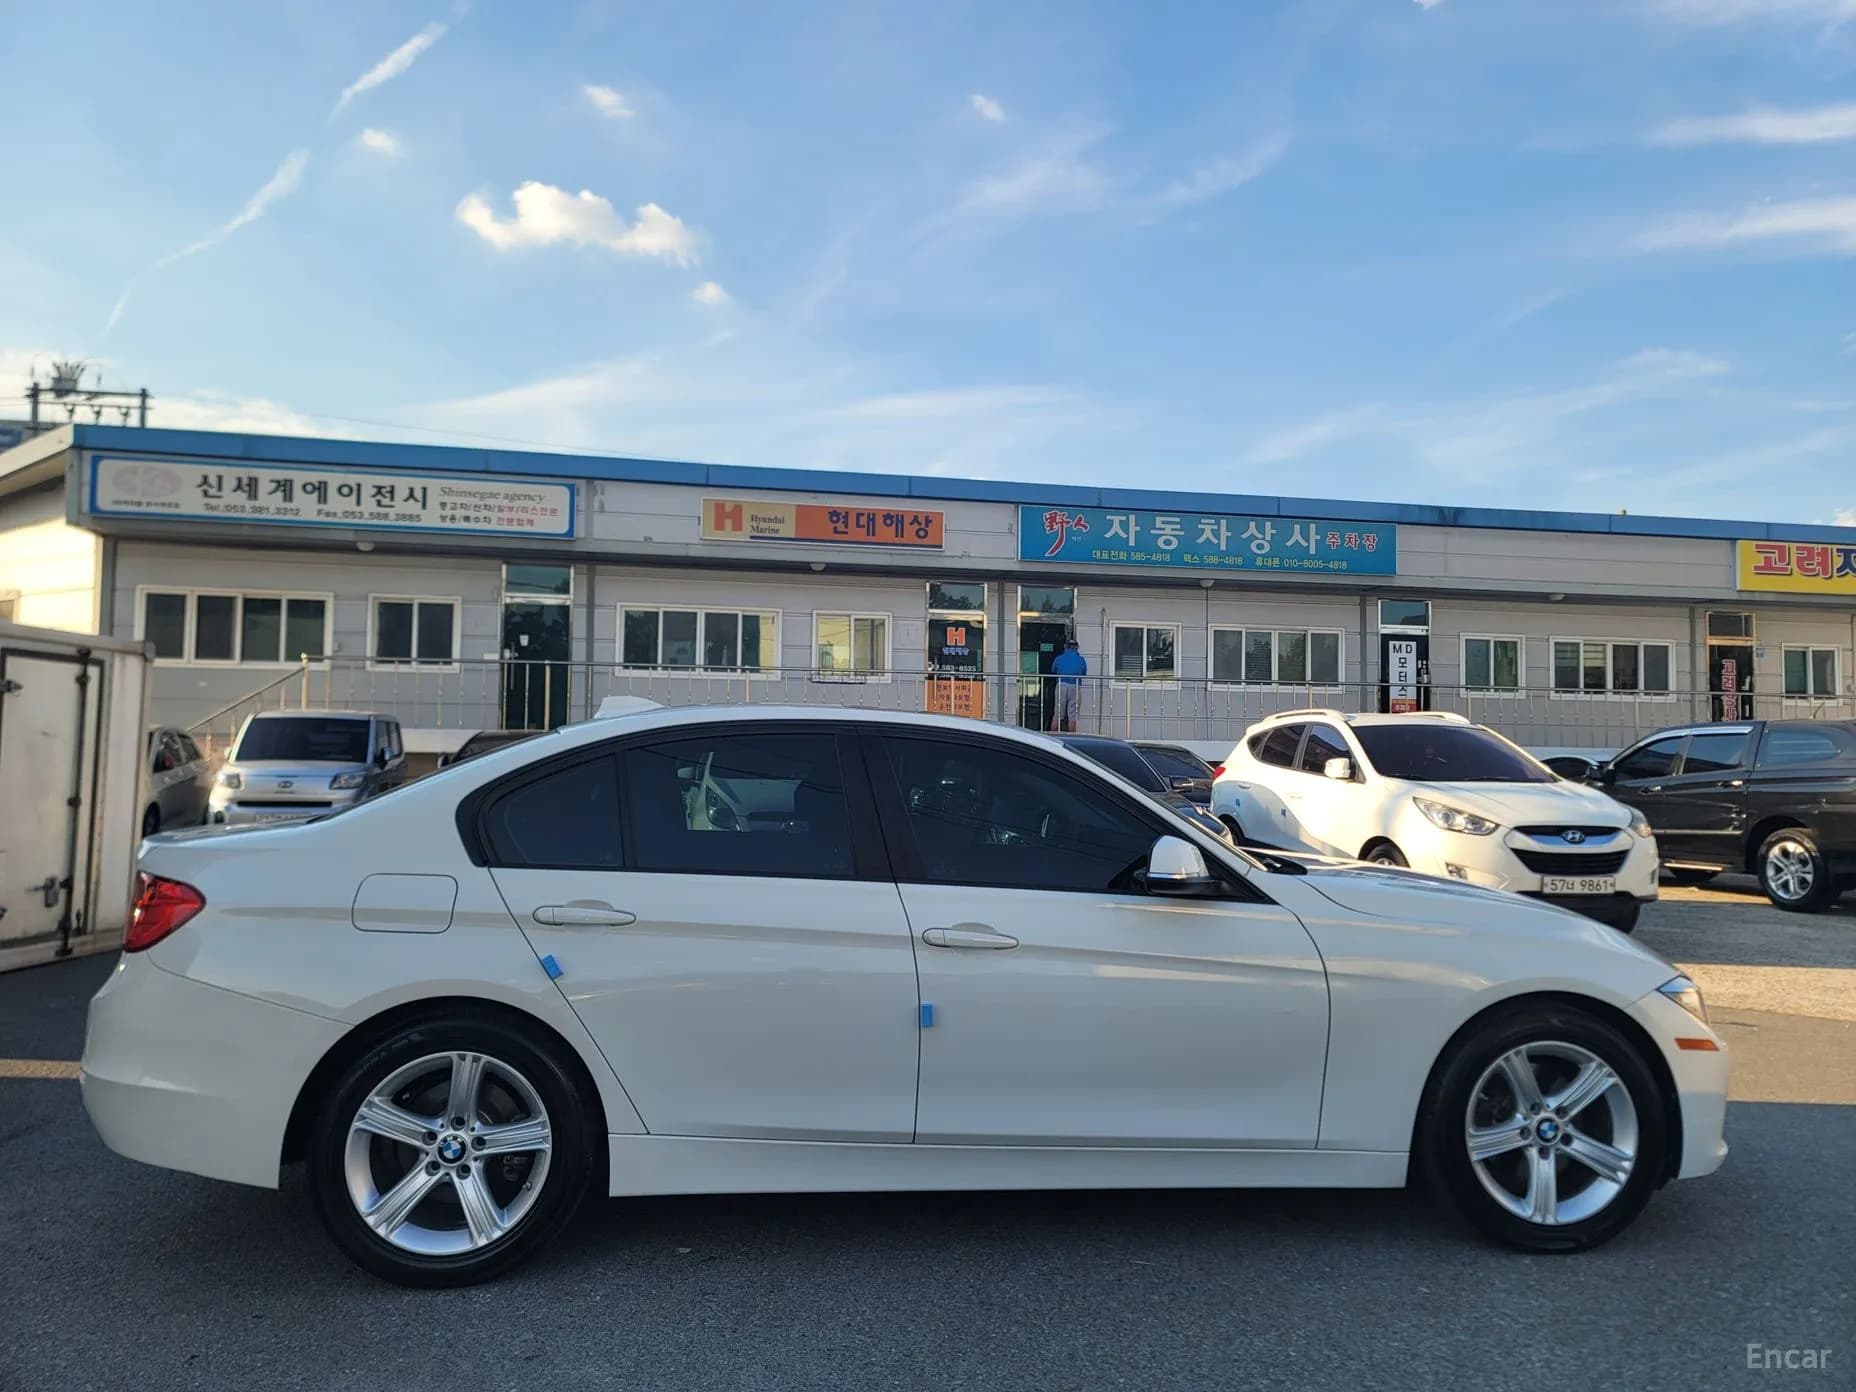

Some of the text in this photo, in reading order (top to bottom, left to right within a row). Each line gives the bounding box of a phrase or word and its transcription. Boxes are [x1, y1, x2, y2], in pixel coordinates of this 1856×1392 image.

[195, 473, 429, 511] 신세계에이전시
[503, 492, 545, 504] agency
[750, 513, 785, 525] Hyundai
[828, 509, 933, 539] 현대해상
[750, 525, 781, 535] Marine
[1104, 514, 1379, 555] 자동차상사 주차장
[1392, 643, 1413, 654] MD
[1580, 879, 1608, 891] 9861
